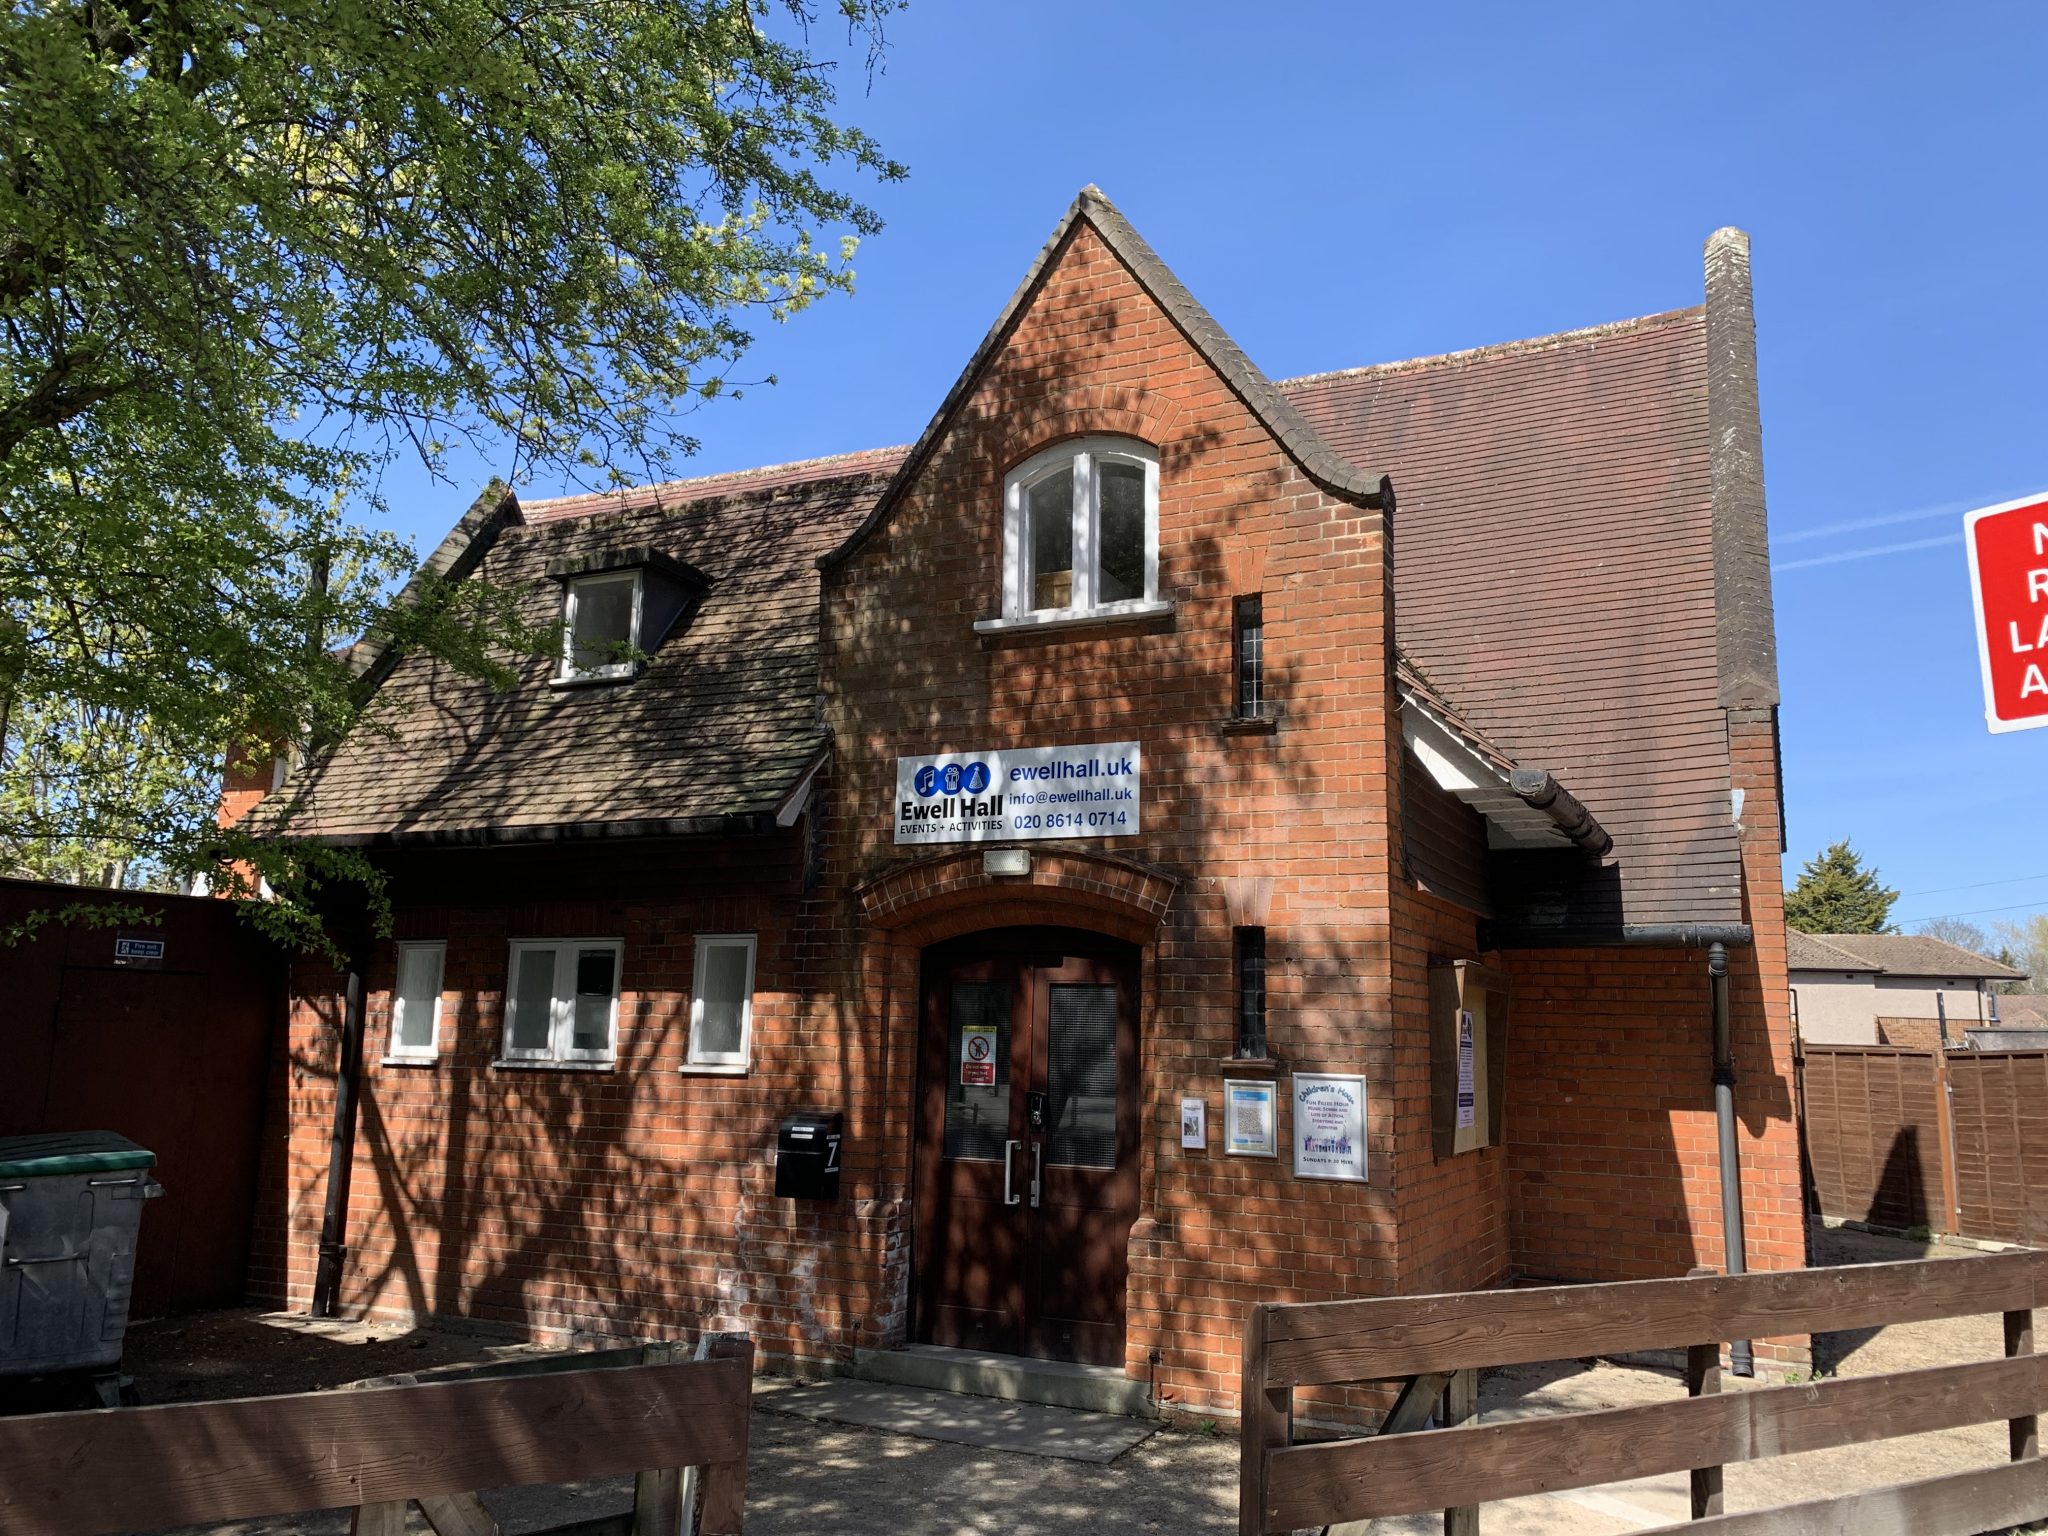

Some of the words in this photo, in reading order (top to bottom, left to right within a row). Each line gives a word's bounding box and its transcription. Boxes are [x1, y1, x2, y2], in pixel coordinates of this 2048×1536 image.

[1009, 757, 1133, 781] ewellhall.uk
[1009, 787, 1133, 805] info@ewellhall.uk
[901, 798, 956, 820] Ewell
[960, 795, 1004, 818] Hall
[900, 823, 937, 834] EVENTS
[949, 820, 1003, 832] ACTIVITIES
[1014, 814, 1041, 830] 020
[1046, 812, 1083, 828] 8614
[1088, 811, 1127, 826] 0714
[827, 1141, 838, 1167] 7
